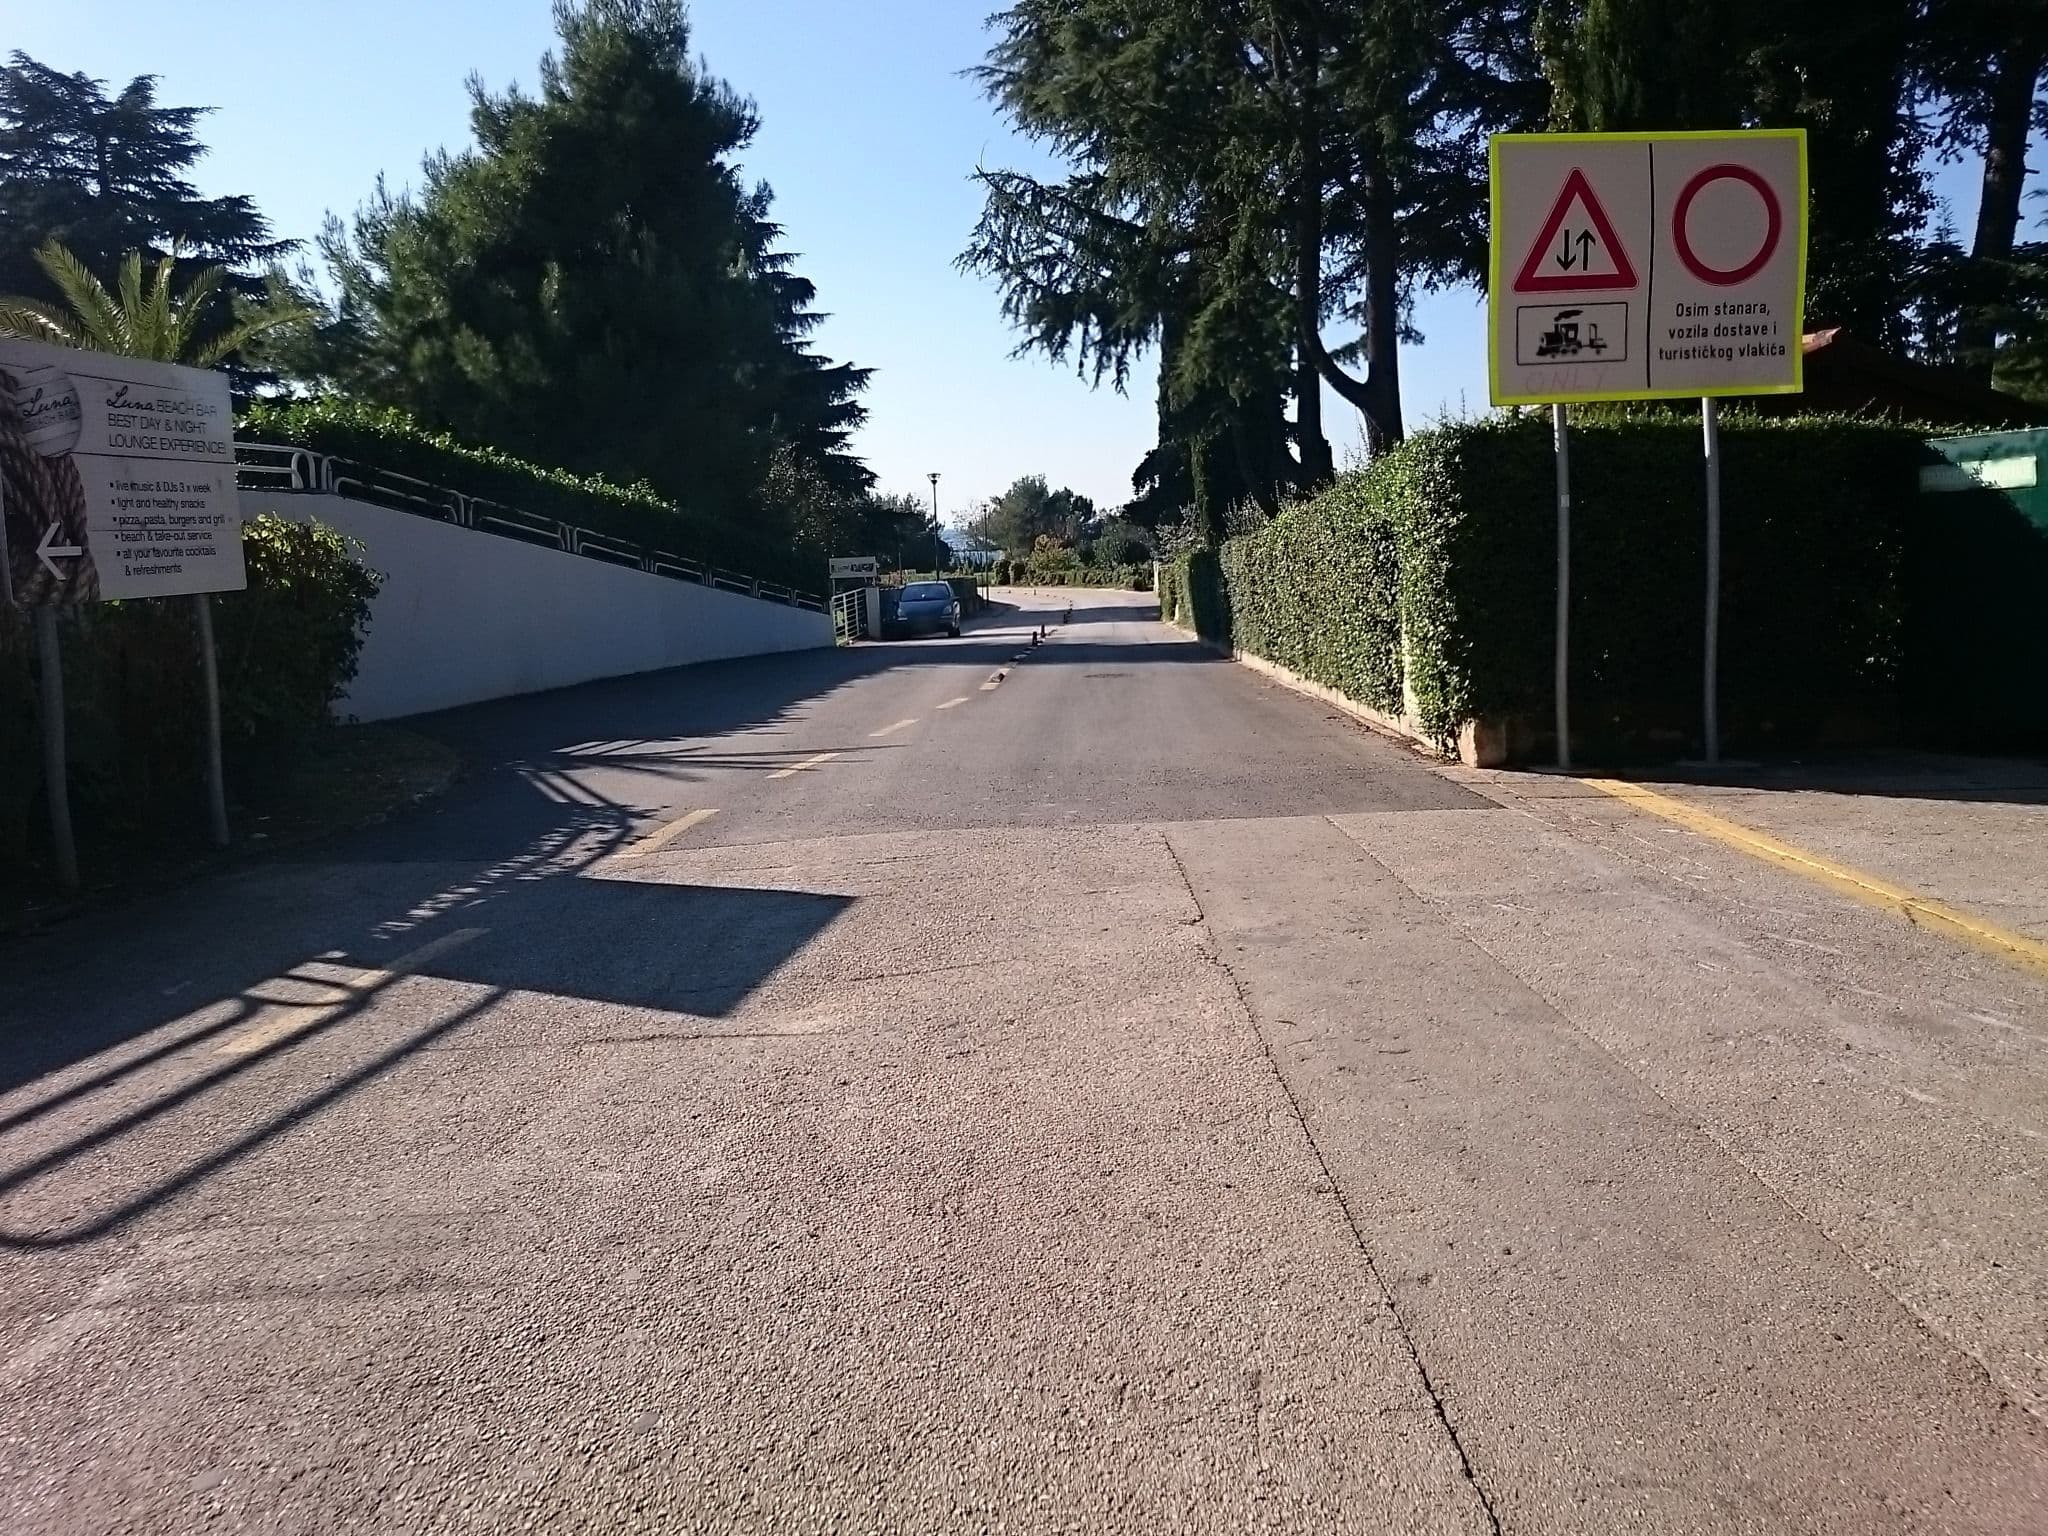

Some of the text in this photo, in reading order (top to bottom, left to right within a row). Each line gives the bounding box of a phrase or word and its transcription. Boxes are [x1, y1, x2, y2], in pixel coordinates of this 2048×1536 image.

[1675, 301, 1770, 317] Osim stanara,
[1668, 321, 1777, 339] vozila dostave i
[1658, 342, 1786, 361] turističkog vlakića
[22, 387, 73, 417] Luna
[107, 385, 218, 417] Luna BEACH BAR
[108, 413, 207, 434] BEST DAY & NIGHT
[109, 433, 158, 450] LOUNGE
[130, 481, 154, 492] music
[156, 481, 161, 492] &
[163, 481, 178, 492] DJs
[179, 482, 185, 492] 3
[192, 483, 211, 493] week
[118, 497, 206, 511] light and healthy snacks
[169, 514, 197, 527] burgers
[198, 514, 211, 525] and
[120, 531, 213, 542] beach & take-out service
[122, 547, 216, 560] all your favourite cocktails
[125, 563, 183, 576] & refreshments
